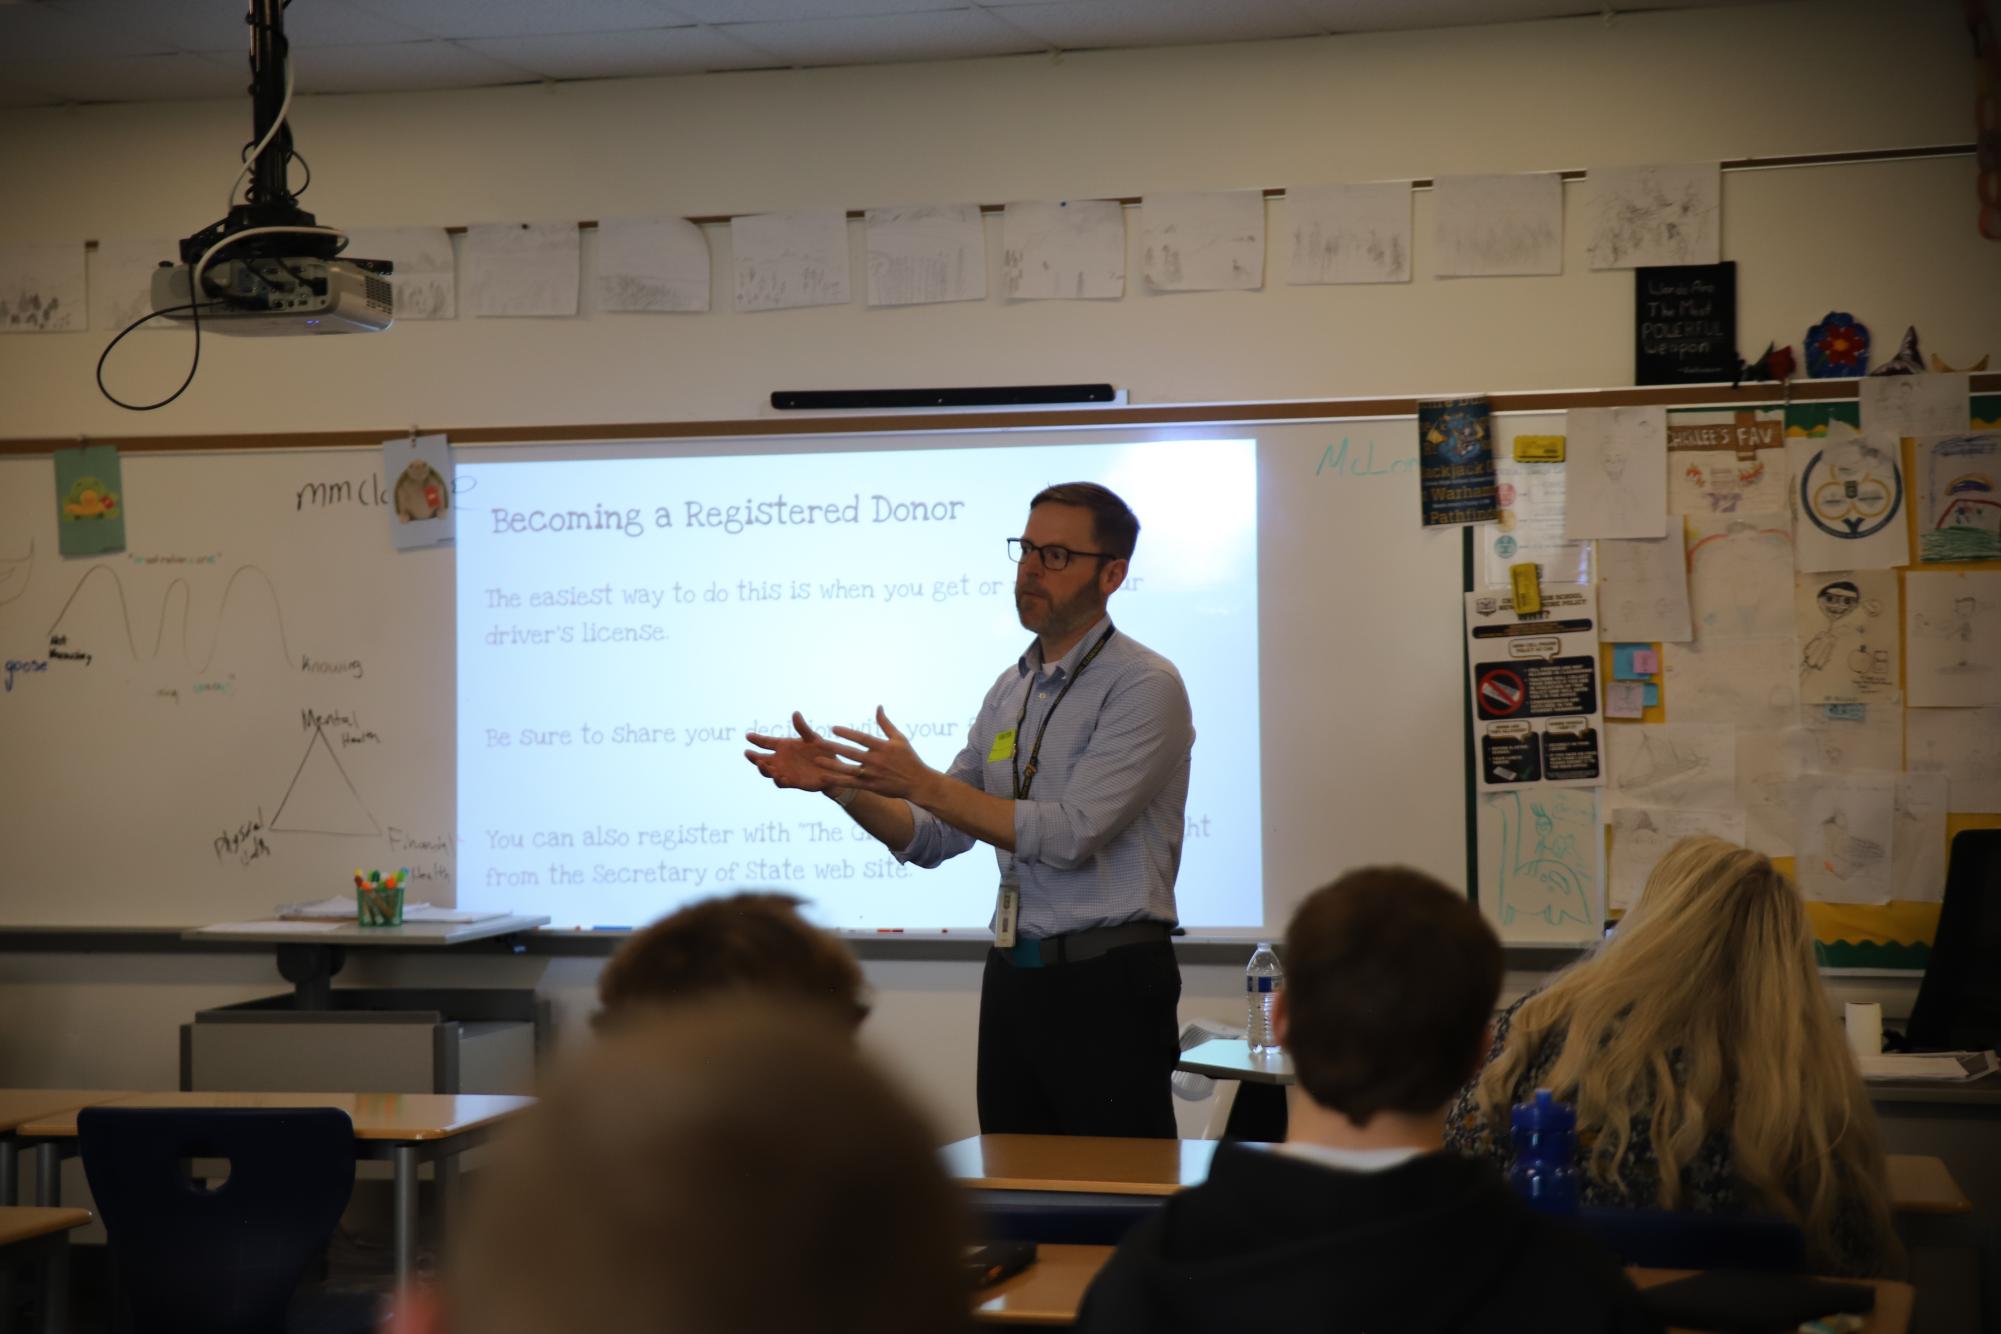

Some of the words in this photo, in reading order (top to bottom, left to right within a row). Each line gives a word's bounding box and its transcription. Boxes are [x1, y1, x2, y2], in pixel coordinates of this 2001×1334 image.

[491, 502, 645, 538] Becoming
[654, 506, 673, 529] a
[684, 494, 861, 535] Registered
[870, 494, 966, 524] Donor
[484, 587, 523, 609] The
[529, 583, 614, 608] easiest
[621, 587, 665, 610] way
[671, 580, 697, 604] to
[702, 580, 731, 603] do
[736, 578, 783, 602] this
[789, 579, 813, 601] is
[818, 577, 876, 600] when
[883, 582, 925, 604] you
[931, 573, 971, 603] get
[977, 580, 1005, 598] or
[484, 623, 576, 646] driver's
[581, 621, 670, 644] license.
[484, 727, 513, 749] Be
[519, 726, 574, 747] sure
[579, 722, 605, 745] to
[610, 722, 677, 745] share
[684, 725, 738, 748] your
[904, 721, 960, 744] your
[484, 829, 526, 851] You
[531, 830, 576, 849] can
[582, 824, 632, 848] also
[637, 821, 736, 852] register
[742, 819, 792, 844] with
[484, 865, 541, 888] from
[548, 862, 586, 887] the
[592, 858, 708, 888] Secretary
[714, 857, 742, 884] of
[745, 857, 807, 882] State
[813, 858, 857, 880] web
